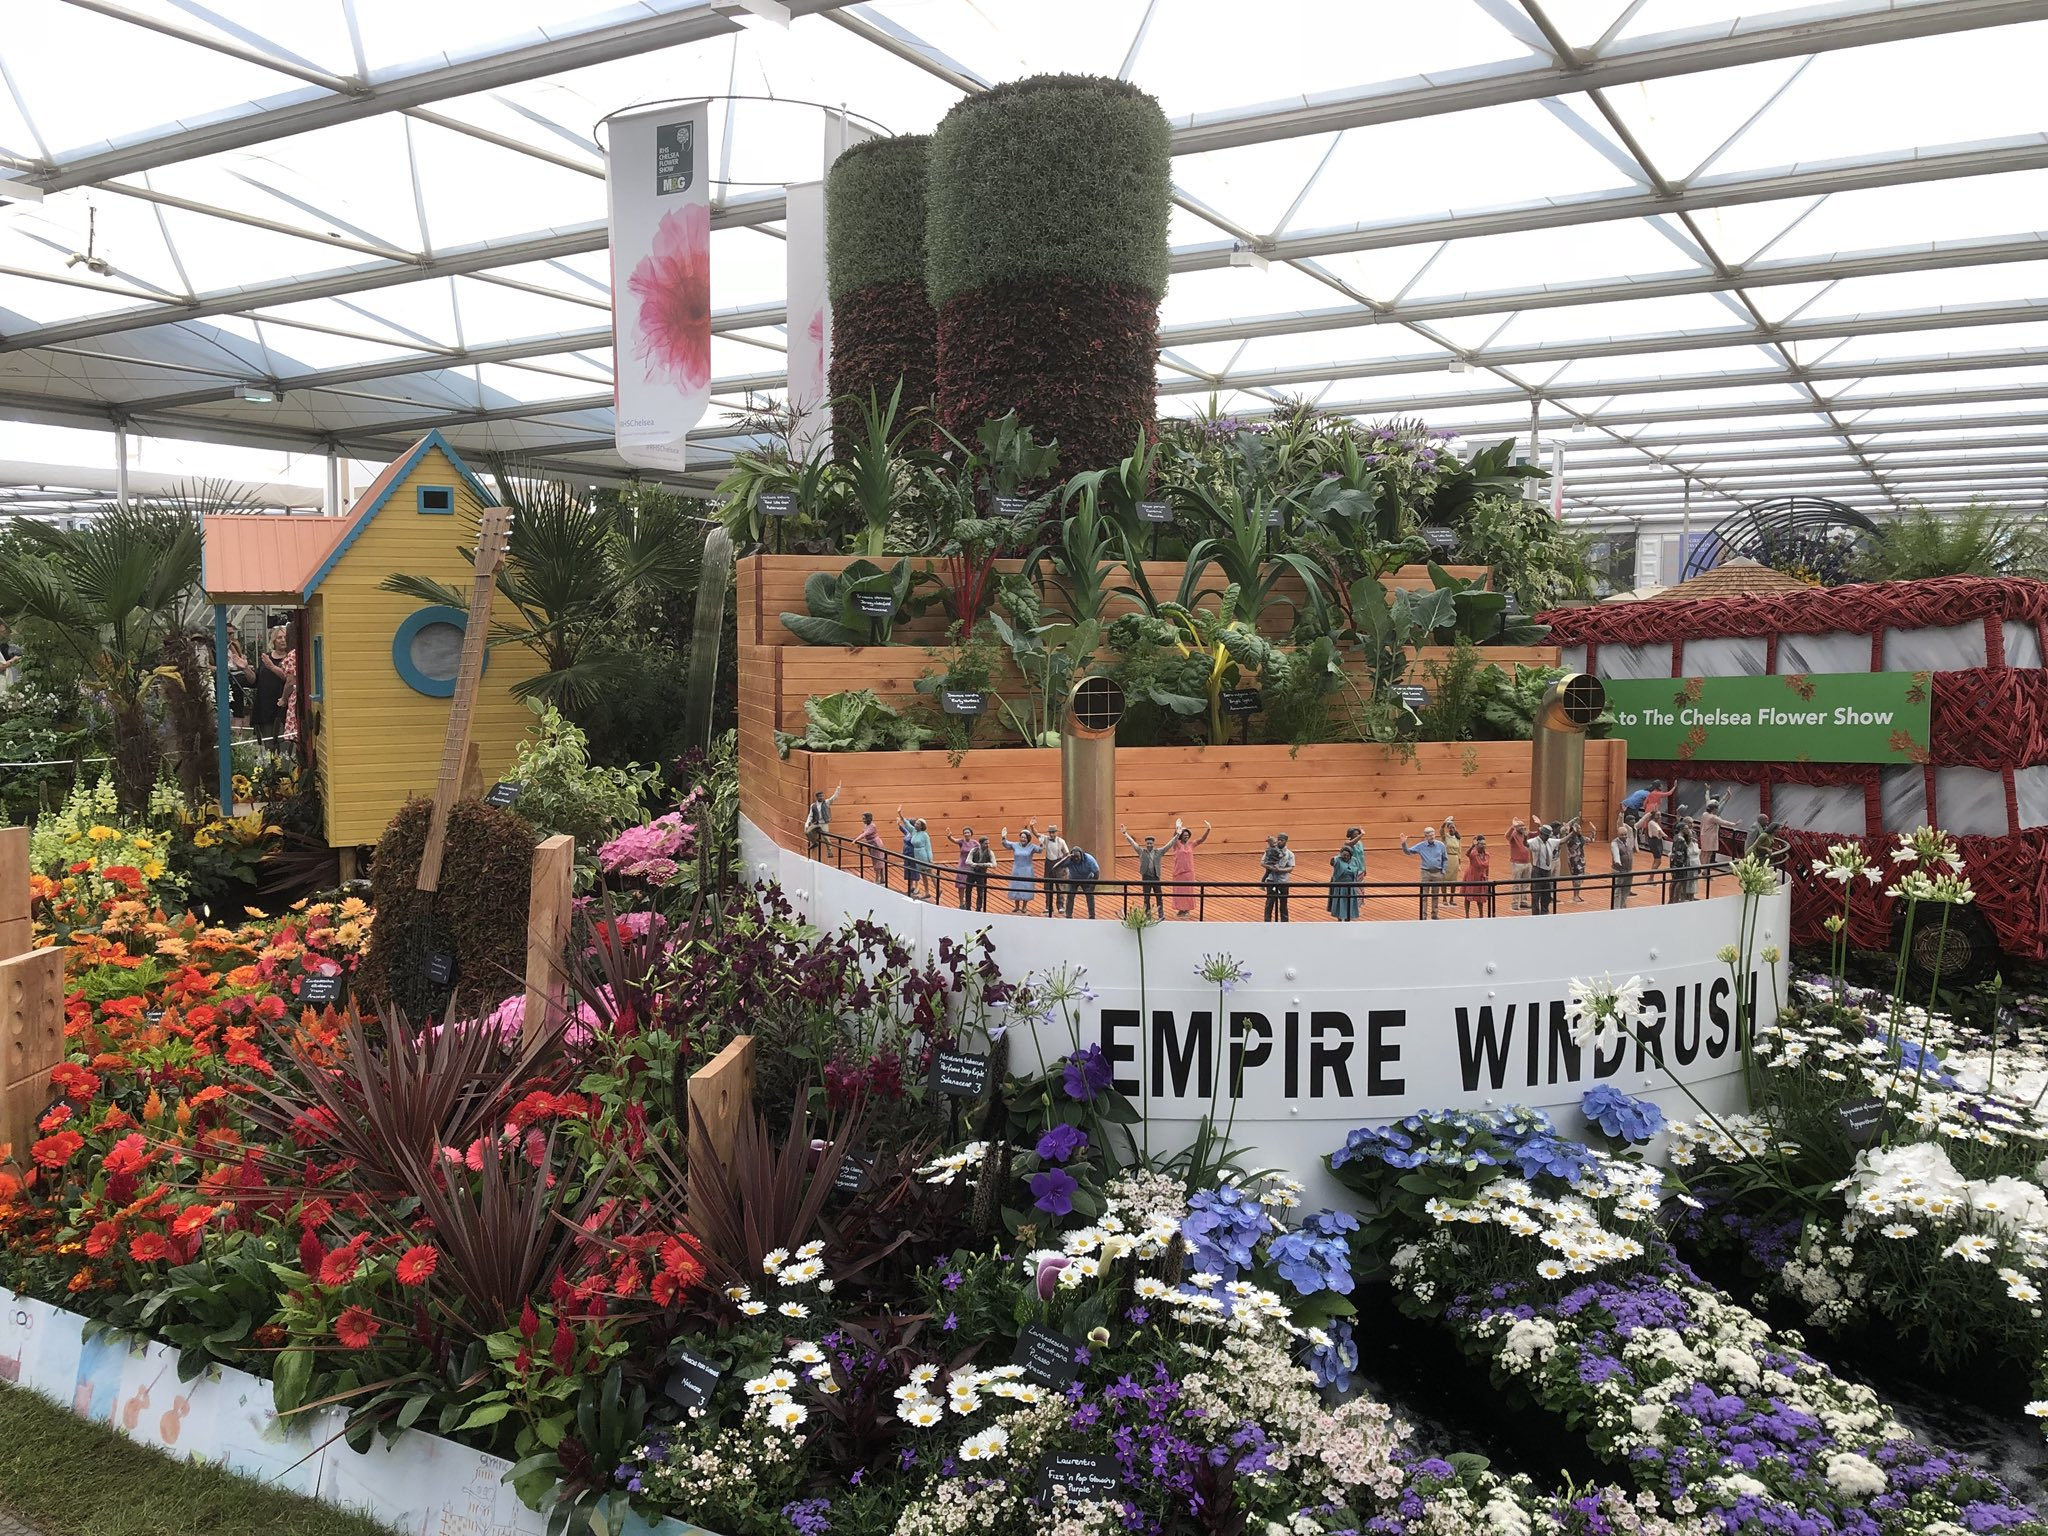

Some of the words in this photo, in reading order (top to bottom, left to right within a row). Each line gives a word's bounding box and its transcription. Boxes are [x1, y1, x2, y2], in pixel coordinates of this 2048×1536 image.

[659, 147, 670, 155] RHS
[659, 152, 680, 161] CHELSEA
[659, 159, 679, 167] FLOWER
[1619, 712, 1637, 725] to
[1643, 709, 1674, 725] The
[1680, 708, 1751, 726] Chelsea
[1758, 708, 1827, 725] Flower
[1834, 707, 1894, 725] Show
[1101, 1009, 1406, 1099] EMPIRE
[973, 1082, 982, 1094] 3
[697, 1395, 706, 1406] 3
